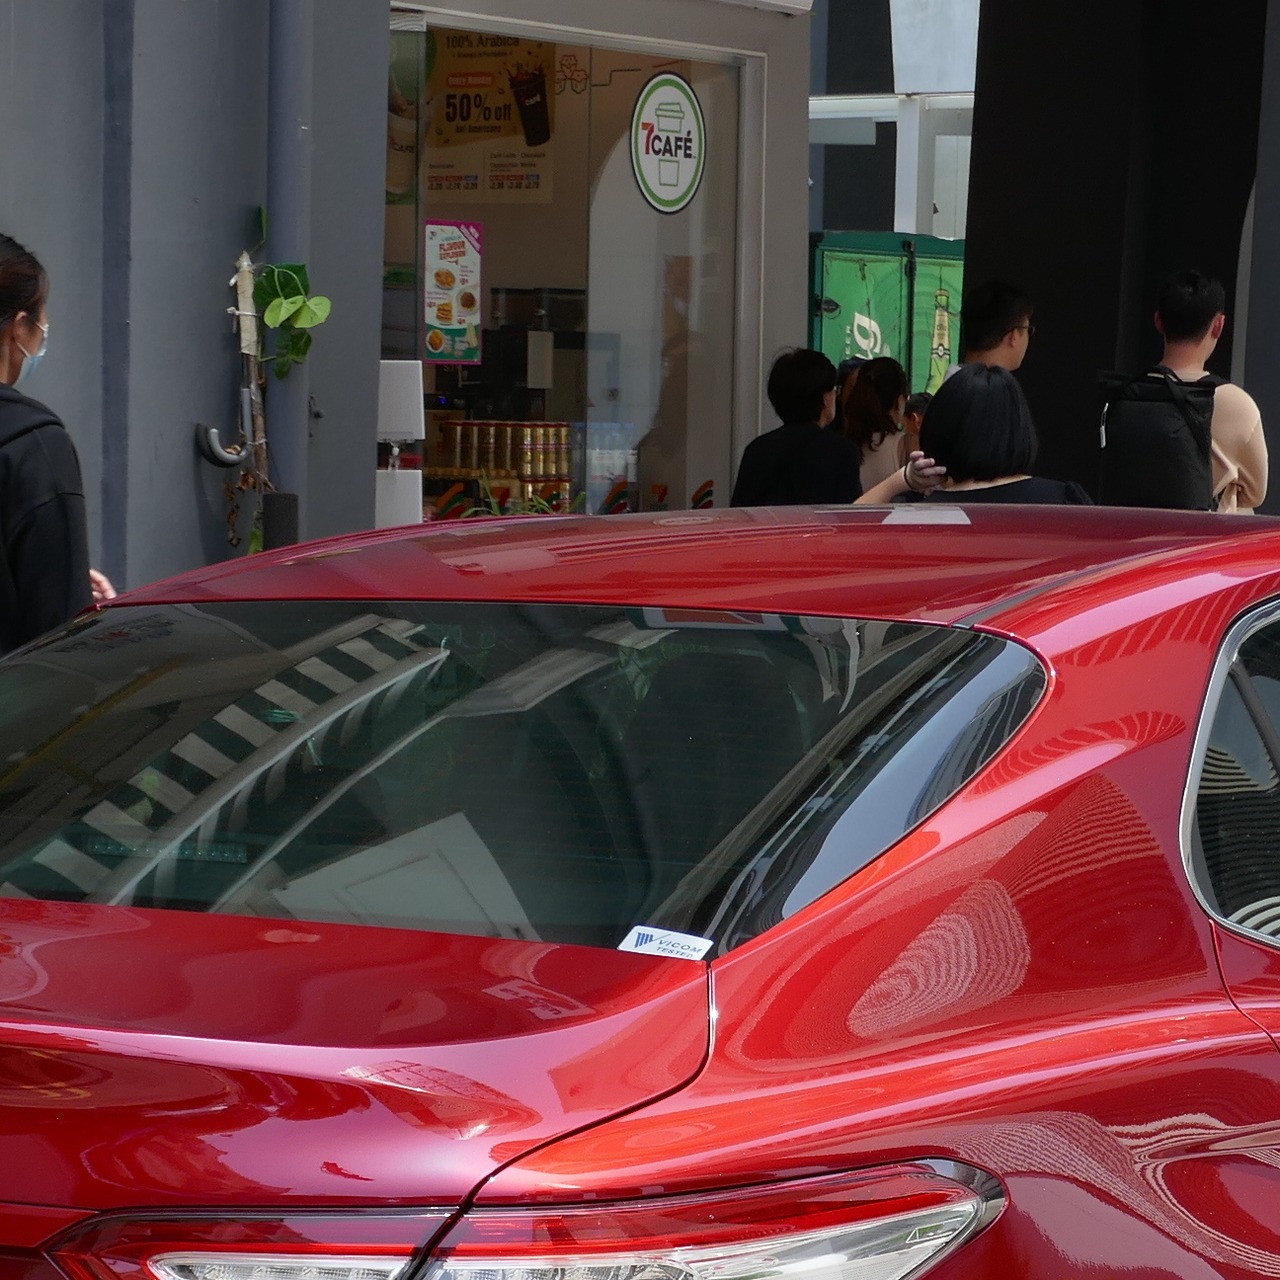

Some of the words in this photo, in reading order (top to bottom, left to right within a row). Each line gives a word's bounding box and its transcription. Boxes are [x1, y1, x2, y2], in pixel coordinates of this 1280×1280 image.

[445, 92, 492, 123] 50%
[494, 103, 512, 121] off
[656, 946, 694, 958] TESTED
[658, 939, 703, 953] VICOM
